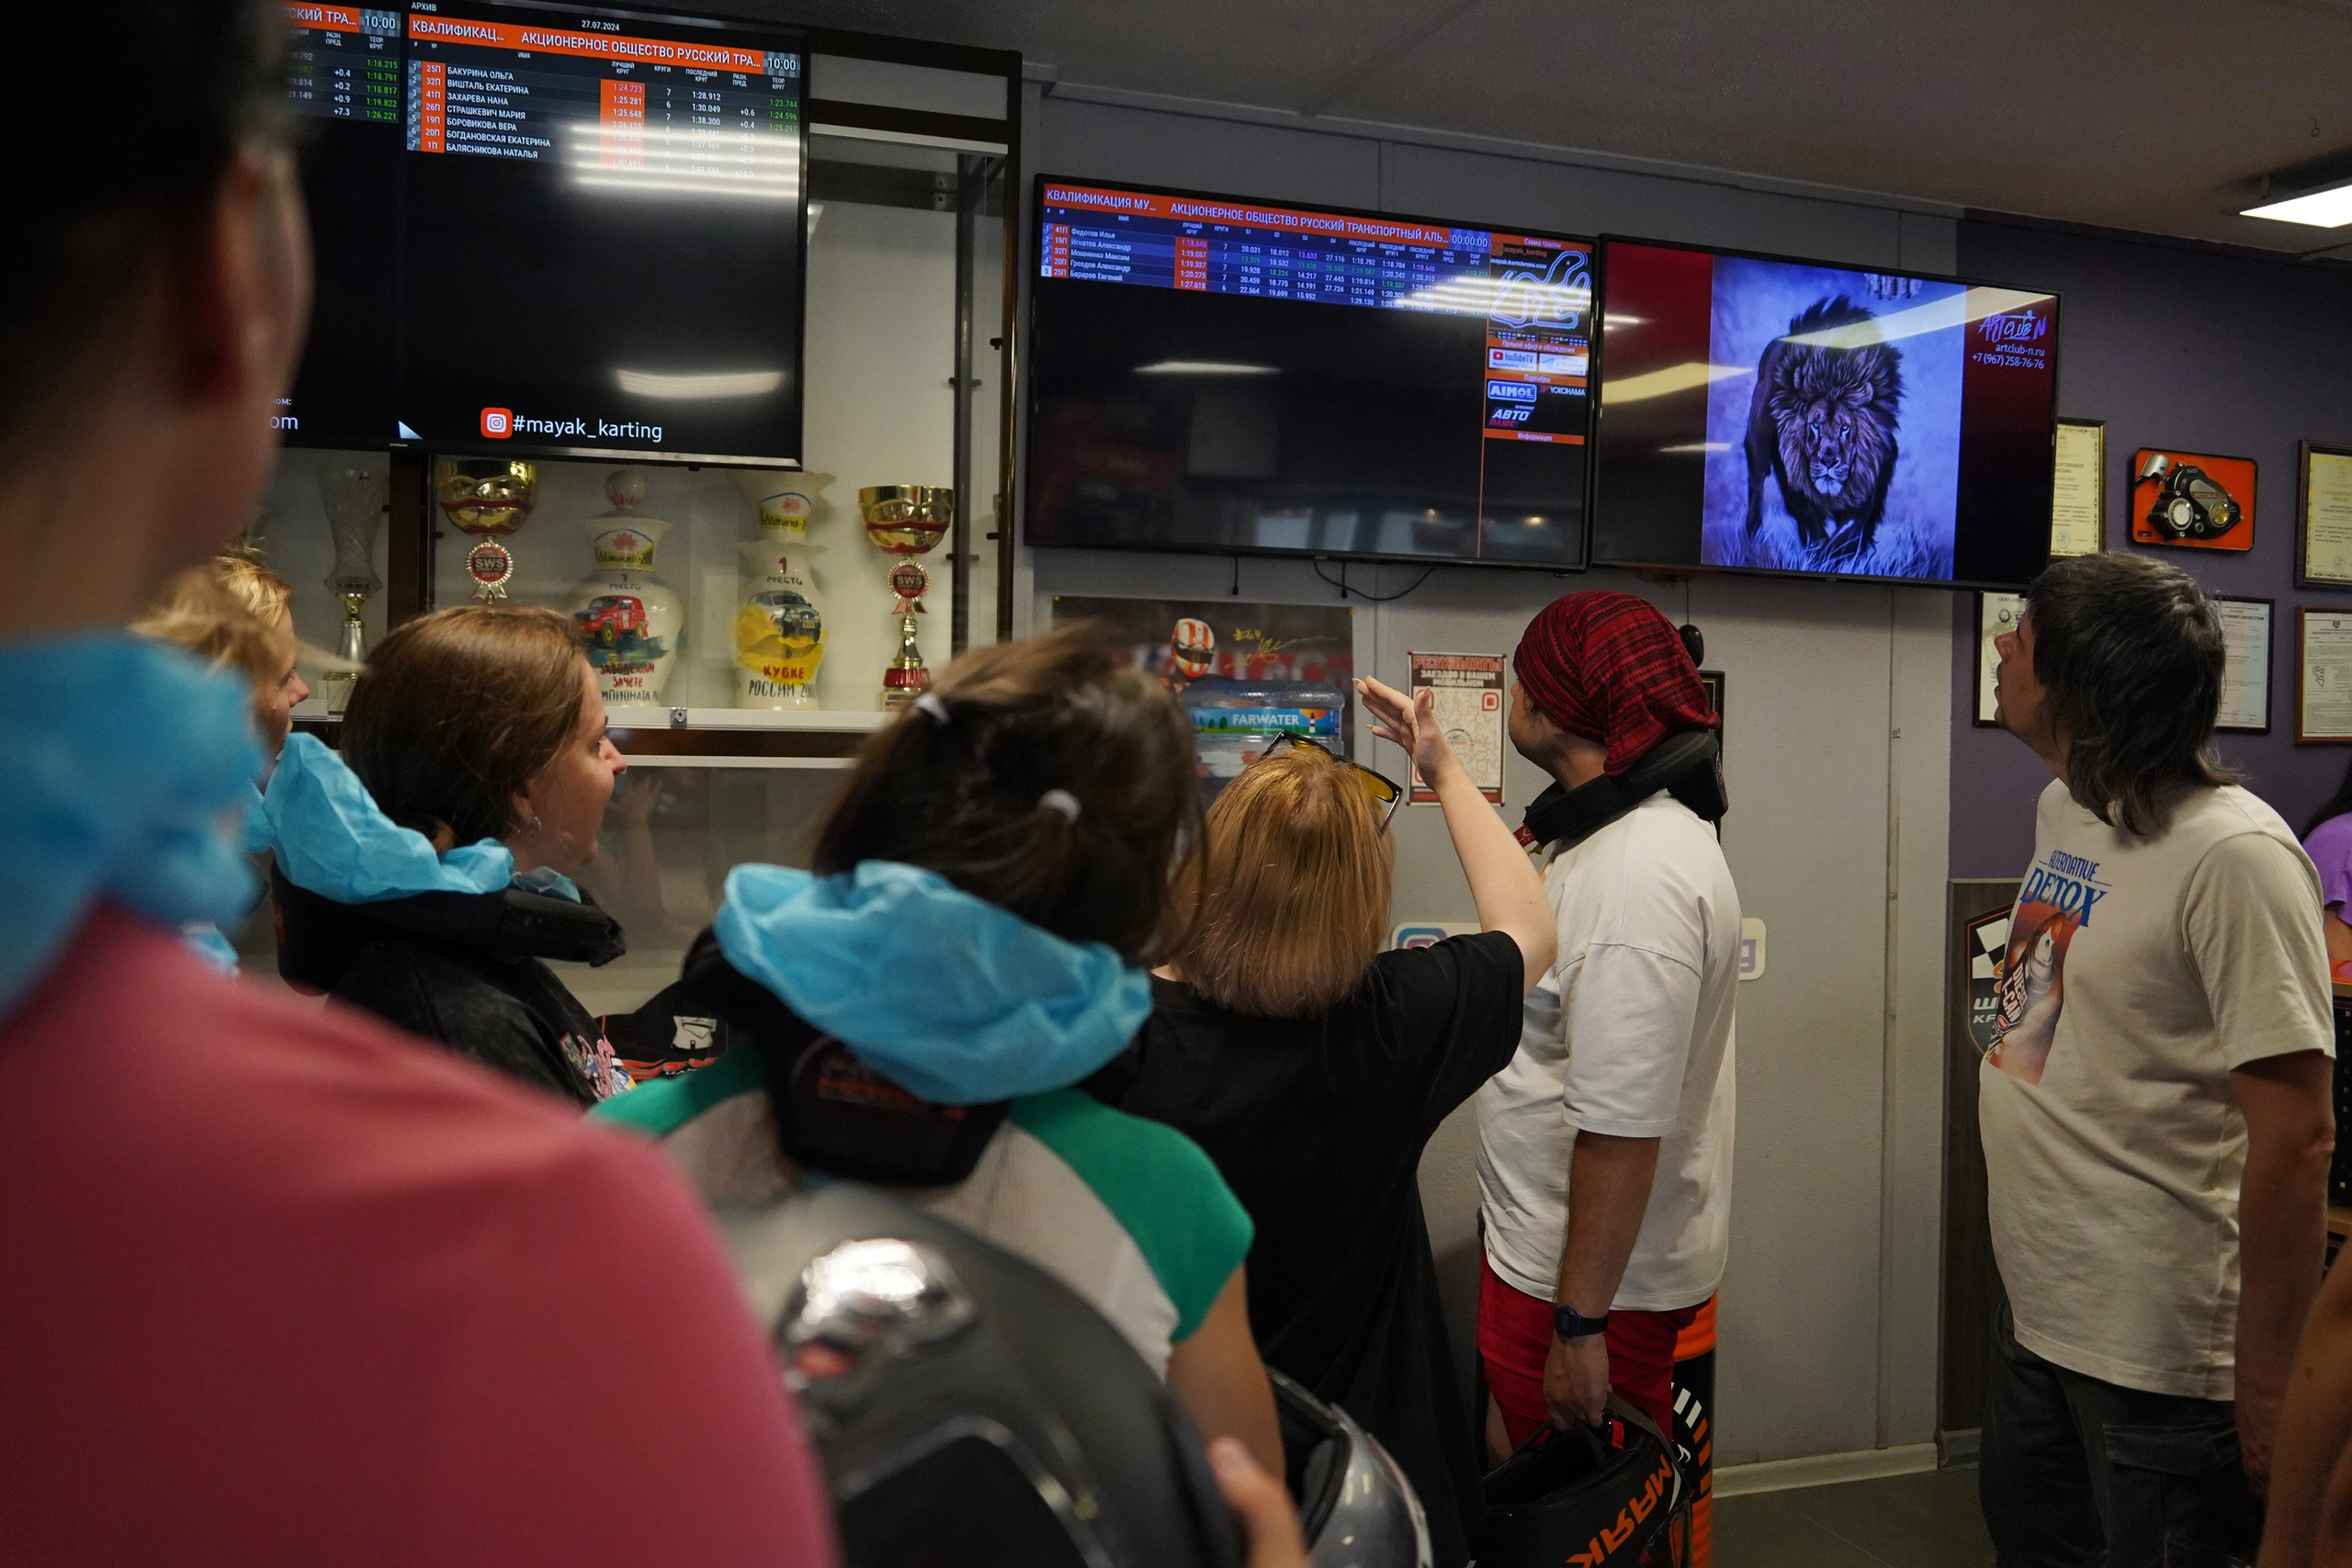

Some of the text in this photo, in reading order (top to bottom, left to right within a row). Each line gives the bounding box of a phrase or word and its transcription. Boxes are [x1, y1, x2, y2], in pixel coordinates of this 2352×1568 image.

[412, 2, 436, 12] АРХИВ
[366, 16, 395, 28] 10:00
[582, 19, 619, 31] 27.07.2024
[521, 32, 609, 54] АКЦИОНЕРНОЕ
[612, 41, 673, 59] ОБЩЕСТВО
[678, 49, 730, 64] РУССКИЙ
[368, 59, 398, 69] 1:18.215
[612, 61, 635, 69] ЛУЧШИЙ
[767, 58, 796, 71] 10:00
[334, 69, 350, 77] +0.4
[368, 73, 397, 82] 1:18.791
[447, 67, 514, 81] БАКУРИНА ОЛЬГА
[686, 69, 718, 77] ПОСЛЕДНИЙ
[368, 85, 397, 95] 1:18.817
[447, 80, 529, 95] ВИШТАЛЬ ЕКАТЕРИНА
[447, 93, 508, 106] ЗАХАРЕВА НАНА
[613, 96, 642, 105] 1:25.281
[693, 91, 720, 101] 1:28.912
[367, 97, 397, 107] 1:19.822
[425, 103, 440, 111] 26П
[447, 106, 526, 119] СТРАШКЕВИЧ МАРИЯ
[613, 108, 642, 118] 1:25.648
[692, 104, 720, 113] 1:30.049
[741, 108, 755, 117] +0.6
[367, 110, 396, 120] 1:26.221
[447, 118, 517, 131] БОРОВИКОВА ВЕРА
[692, 116, 720, 126] 1:38.300
[425, 129, 440, 137] 20П
[447, 130, 550, 147] БОГДАНОВСКАЯ ЕКАТЕРИНА
[447, 143, 537, 159] БАЛЯСНИКОВА НАТАЛЬЯ
[1046, 189, 1132, 208] КВАЛИФИКАЦИЯ
[1170, 203, 1243, 220] АКЦИОНЕРНОЕ
[1246, 211, 1298, 226] ОБЩЕСТВО
[1301, 217, 1344, 231] РУССКИЙ
[1347, 222, 1421, 240] ТРАНСПОРТНЫЙ
[1071, 228, 1115, 239] Федотов Илья
[1071, 239, 1131, 252] Игнатов Александр
[1453, 234, 1487, 247] 00:00:00
[1105, 252, 1129, 262] Максим
[1270, 248, 1289, 256] 18.012
[1270, 258, 1289, 266] 18.532
[1326, 254, 1345, 263] 27.116
[1352, 257, 1375, 265] 1:18.792
[1097, 262, 1130, 272] Александр
[1412, 264, 1435, 272] 1:18.646
[1098, 273, 1123, 281] Евгений
[1326, 275, 1344, 283] 27.445
[1382, 271, 1405, 279] 1:20.243
[1412, 274, 1435, 282] 1:20.315
[1180, 280, 1205, 288] 1:27.618
[1351, 277, 1374, 286] 1:19.814
[1240, 287, 1260, 295] 22.564
[1325, 285, 1344, 293] 27.724
[1297, 291, 1316, 299] 15.952
[1996, 344, 2044, 356] artclub-n.ru
[1973, 353, 2044, 369] +7 (967) 258-76-76
[1550, 387, 1586, 396] YOKOHAMA
[1492, 409, 1530, 421] АВТО
[512, 414, 662, 443] #mayak_karting
[475, 558, 504, 568] SWS
[778, 556, 786, 574] 1
[898, 576, 922, 585] SWS
[1413, 656, 1502, 671] РЕЗУЛЬТАТЫ
[763, 665, 804, 679] КУБКЕ
[749, 680, 795, 698] РОССИИ
[1232, 715, 1299, 725] FARWATER
[2019, 867, 2108, 928] DETOX
